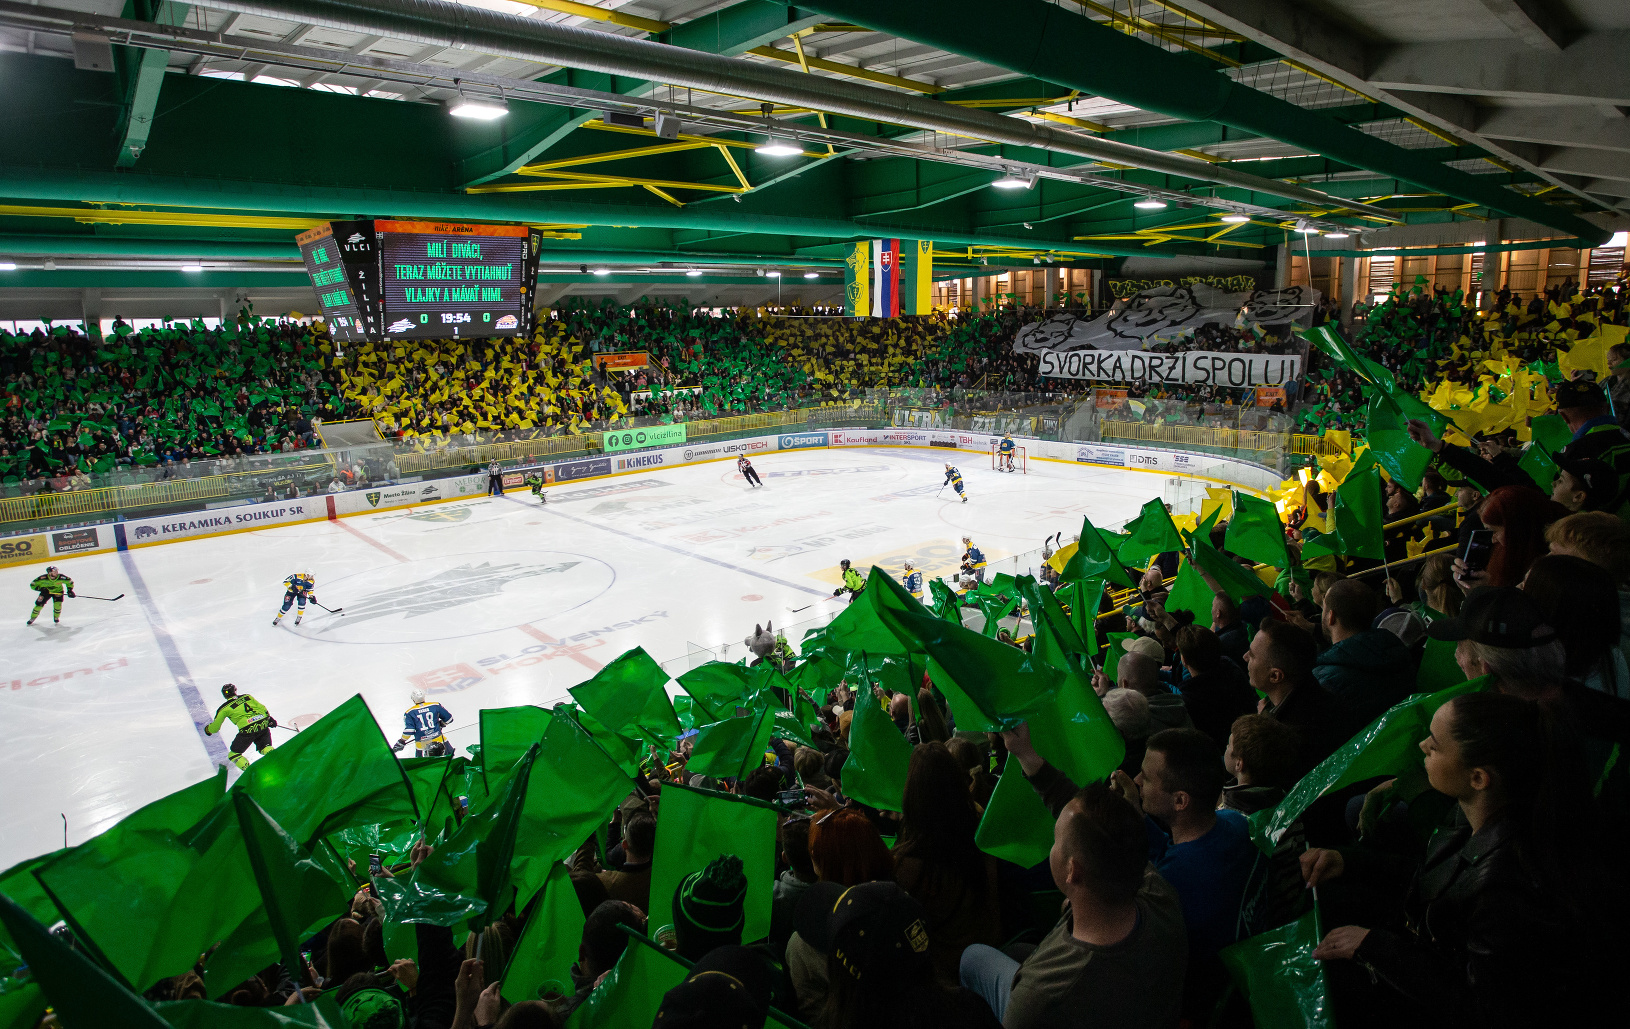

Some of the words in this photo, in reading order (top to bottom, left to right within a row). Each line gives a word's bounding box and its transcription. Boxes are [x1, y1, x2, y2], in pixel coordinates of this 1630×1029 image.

[427, 240, 447, 258] MILÍ
[452, 241, 483, 260] DIVÁCI,
[395, 265, 424, 279] TERAZ
[427, 262, 462, 279] MÔŽETE
[465, 263, 512, 280] VYTIAHNUŤ
[405, 287, 440, 302] VLAJKY
[443, 288, 450, 302] A
[452, 285, 479, 302] MÁVAŤ
[482, 287, 504, 302] NIMI.
[420, 314, 428, 323] 0
[441, 313, 471, 323] 19:54
[482, 313, 491, 322] 0
[1042, 352, 1126, 380] SVORKA
[1131, 351, 1187, 383] DRŽÍ
[794, 436, 824, 445] ŠPORT
[959, 435, 973, 444] TBH
[454, 476, 486, 488] MEBOR
[162, 516, 232, 534] KERAMIKA
[236, 508, 286, 523] SOUKUP
[289, 506, 304, 515] SR
[59, 542, 95, 551] OBLEČENIE
[476, 609, 669, 668] SLOVENSKÝ
[486, 638, 607, 676] HOKEJ
[416, 711, 435, 732] 18
[836, 948, 862, 980] VLCI
